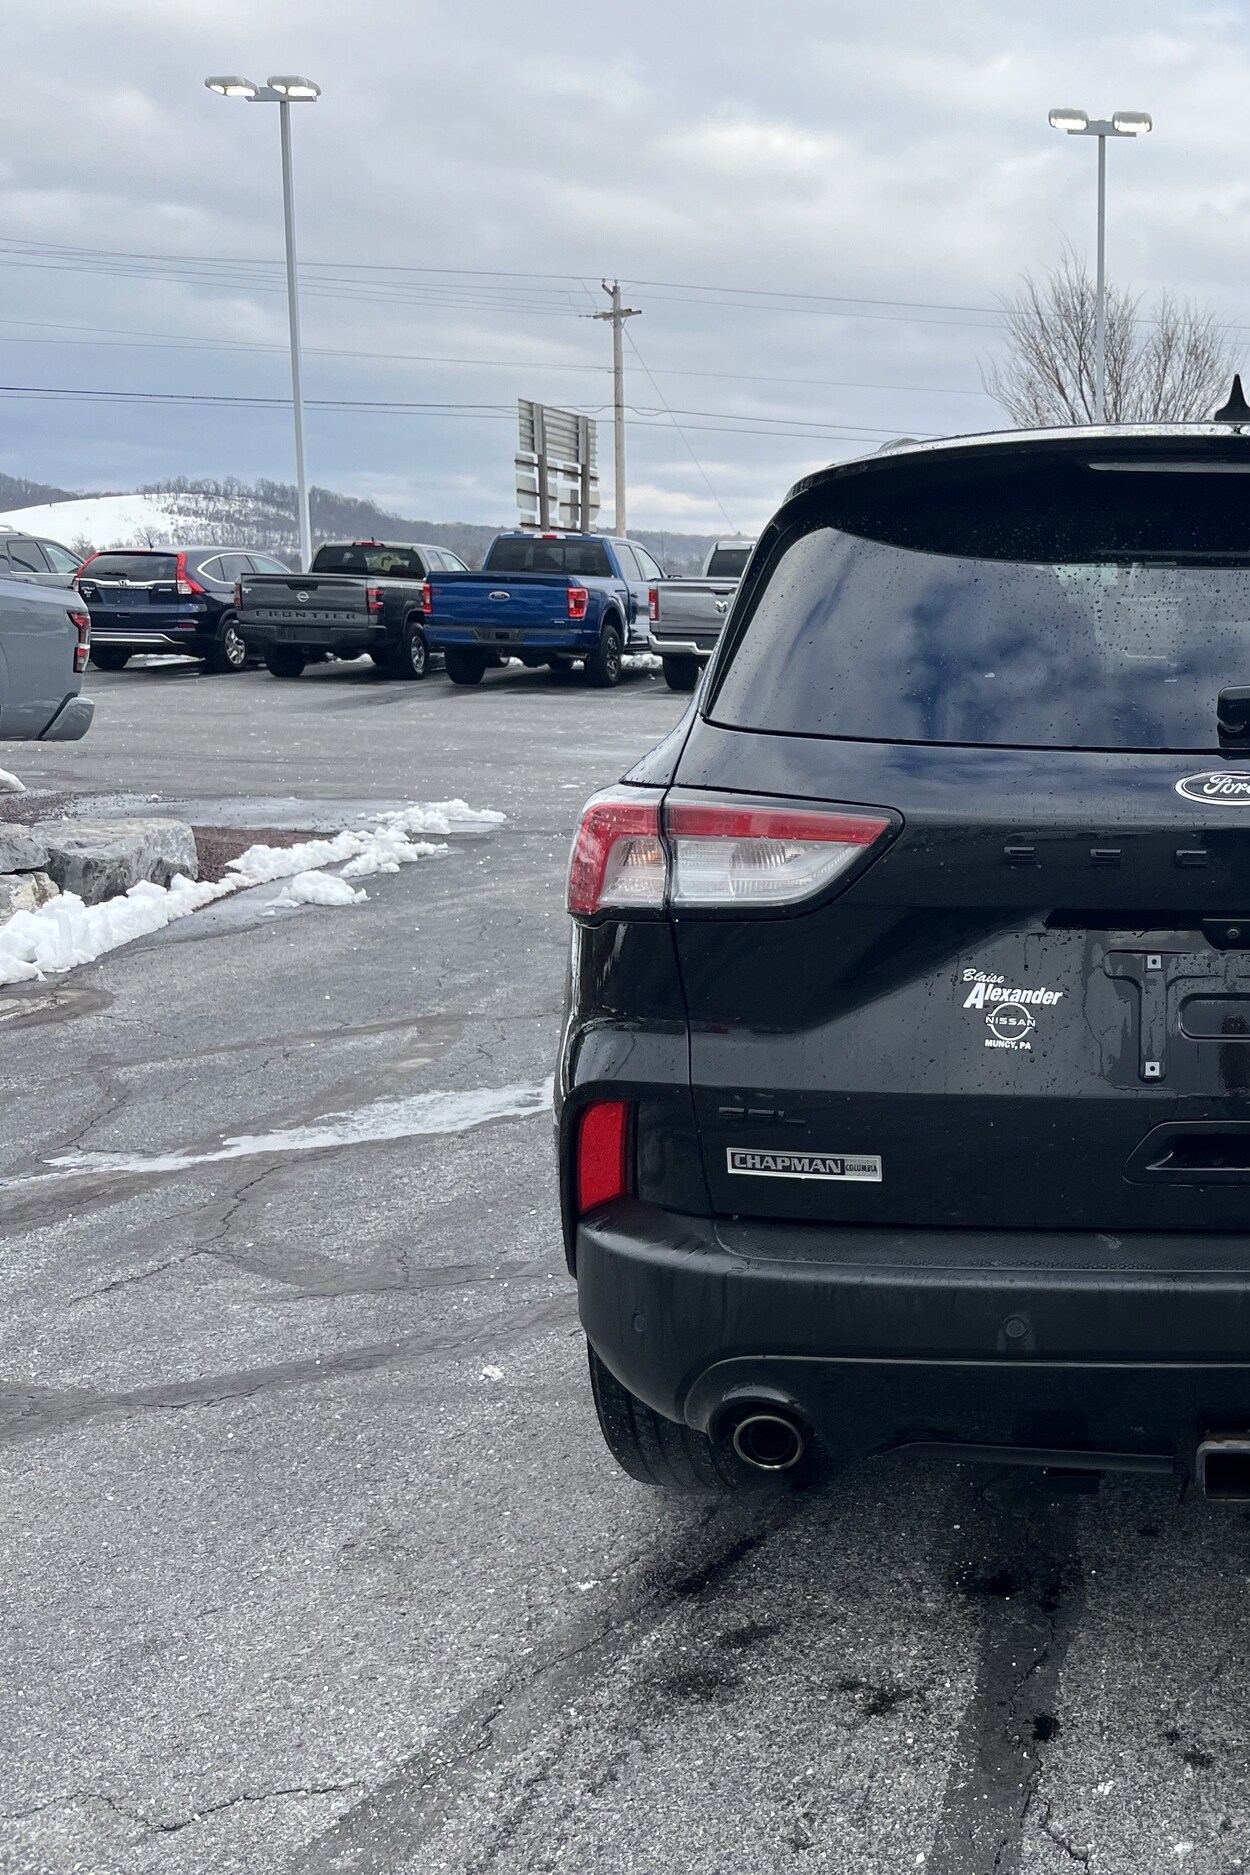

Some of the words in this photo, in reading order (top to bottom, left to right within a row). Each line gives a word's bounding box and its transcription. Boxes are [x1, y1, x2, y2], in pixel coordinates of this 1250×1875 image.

[255, 610, 356, 620] FRONTIER
[962, 968, 1005, 984] Blaise
[962, 982, 1063, 1009] Alexander
[985, 1016, 1036, 1027] NISSAN
[984, 1039, 1018, 1050] MUNCY,
[1019, 1041, 1032, 1050] PA
[733, 1154, 842, 1174] CHAPMAN
[845, 1163, 878, 1173] COLUMBIA
